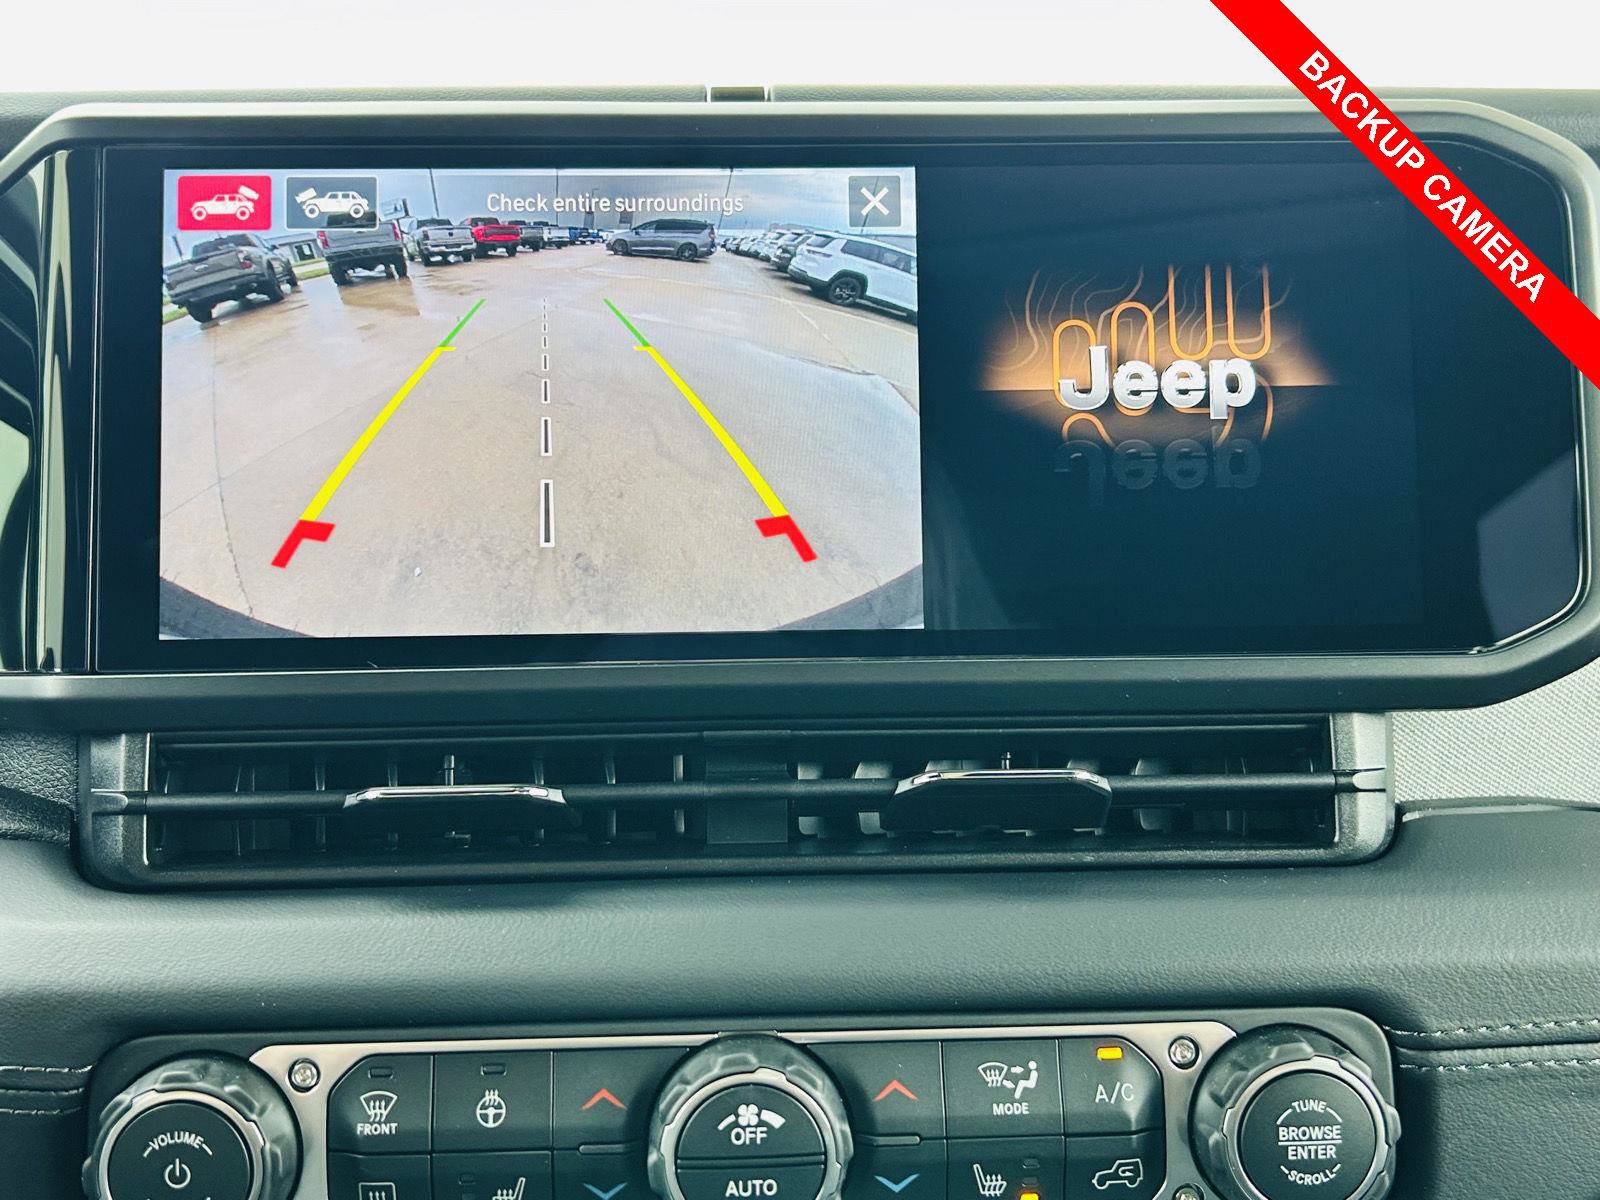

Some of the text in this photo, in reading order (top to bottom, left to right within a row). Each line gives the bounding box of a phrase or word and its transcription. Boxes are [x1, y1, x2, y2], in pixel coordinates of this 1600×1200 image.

[486, 192, 744, 216] Check entire surroundings
[1058, 345, 1257, 420] Jeep
[1095, 1081, 1134, 1104] A/C
[992, 1103, 1030, 1116] MODE
[1291, 1099, 1327, 1114] TUNE
[356, 1122, 399, 1136] FRONT
[730, 1127, 768, 1146] OFF
[1278, 1125, 1342, 1141] BROWSE
[149, 1131, 204, 1150] VOLUME
[1287, 1145, 1337, 1160] ENTER
[1287, 1169, 1336, 1186] SCROLL
[725, 1179, 778, 1198] AUTO
